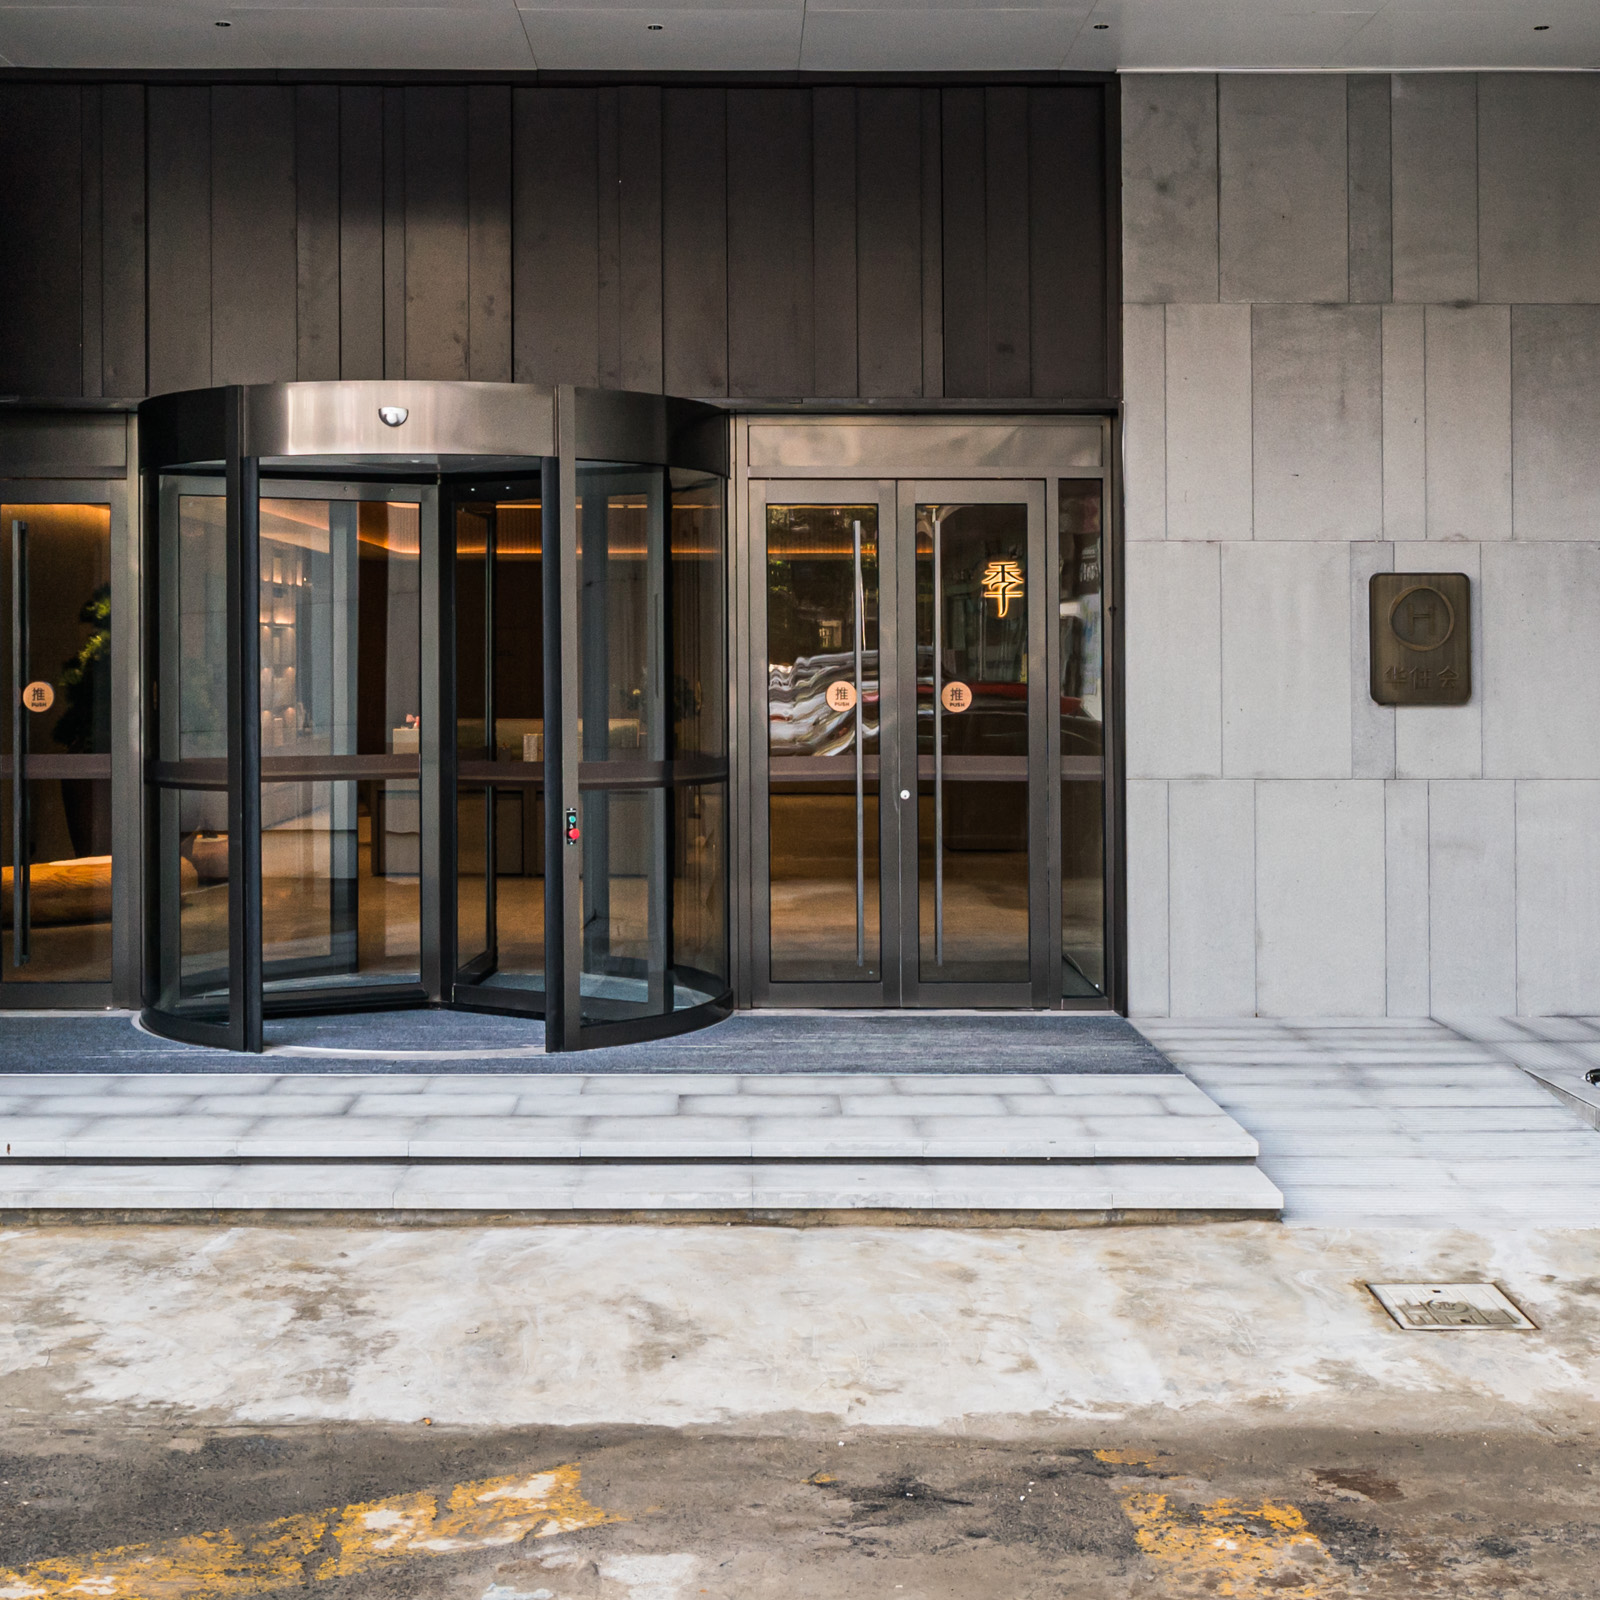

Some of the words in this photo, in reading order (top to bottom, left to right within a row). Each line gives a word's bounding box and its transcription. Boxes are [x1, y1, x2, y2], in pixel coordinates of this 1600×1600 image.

[981, 561, 1024, 618] 季
[1384, 665, 1460, 690] 华住会
[32, 687, 46, 701] 推
[835, 687, 849, 701] 推
[950, 687, 964, 701] 推
